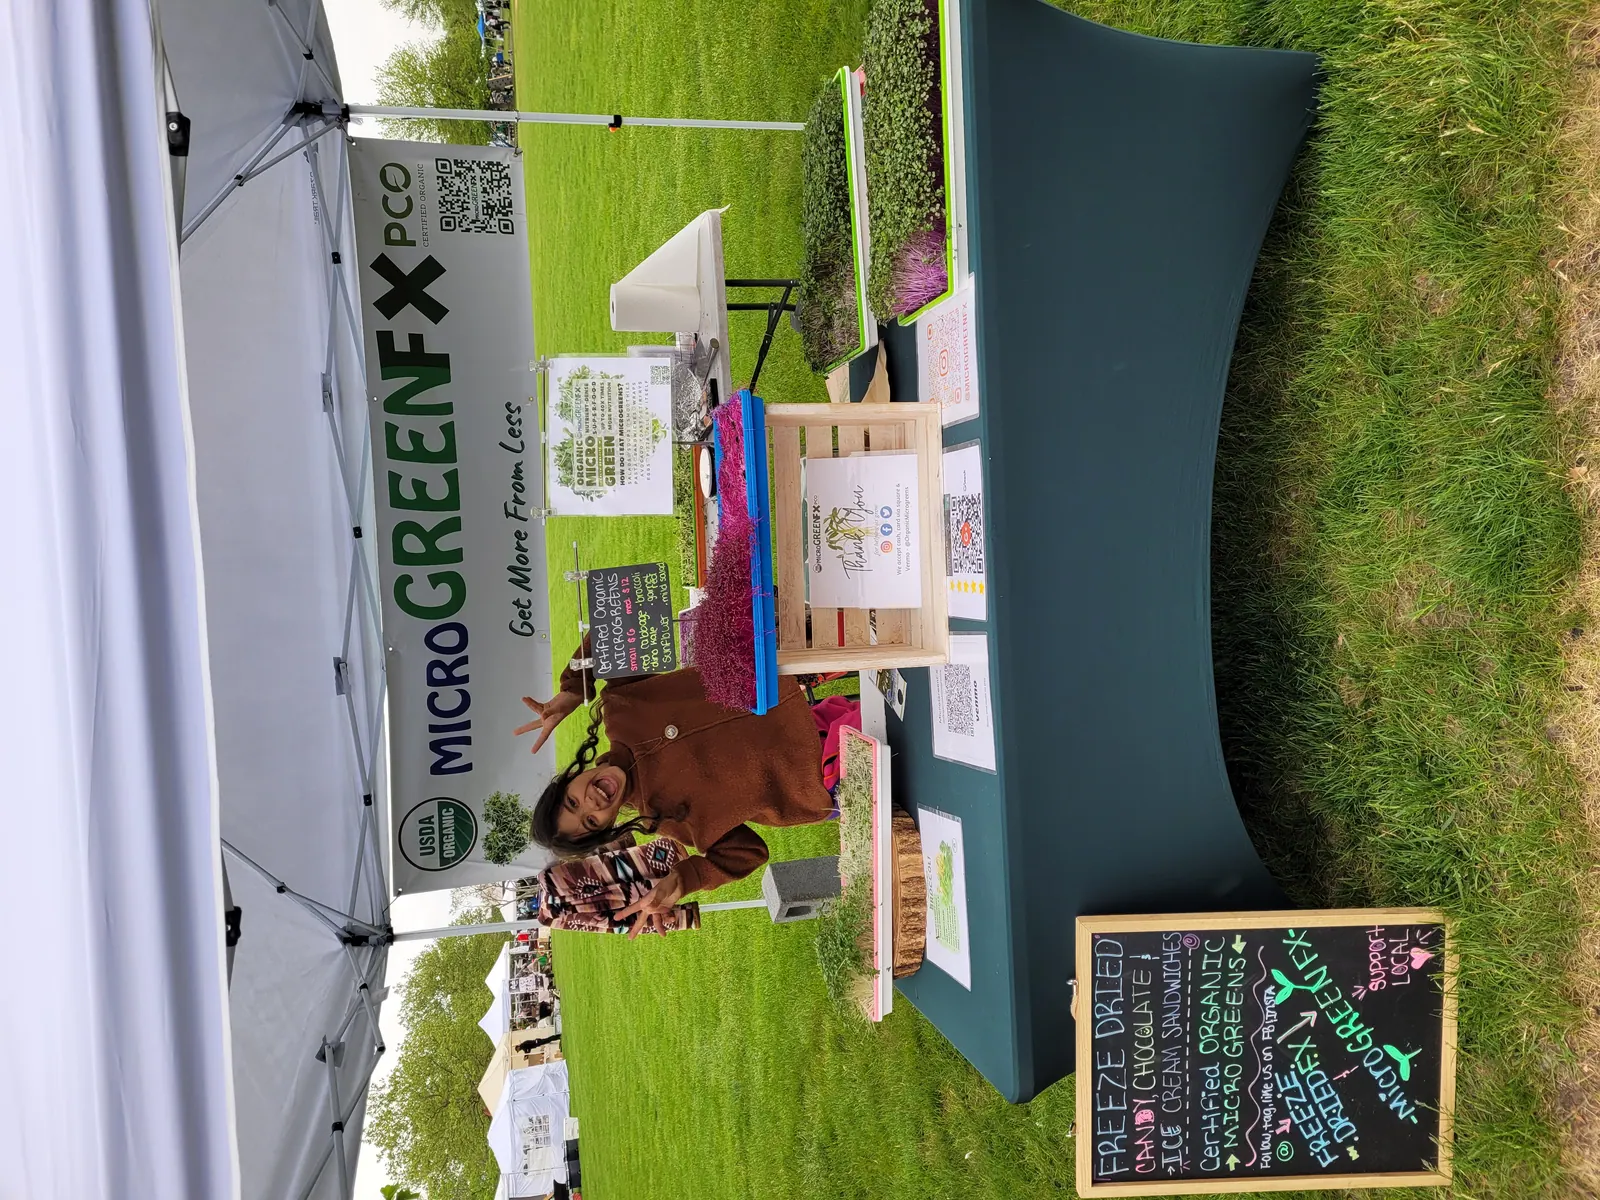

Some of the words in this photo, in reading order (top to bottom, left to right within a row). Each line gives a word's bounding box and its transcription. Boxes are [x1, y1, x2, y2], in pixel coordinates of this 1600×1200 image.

[379, 162, 417, 247] PCO
[416, 163, 426, 202] ORGANIC
[420, 203, 430, 248] CERTIFIED
[498, 401, 526, 454] Less
[601, 422, 606, 430] UP
[576, 440, 584, 486] ORGANIC
[585, 436, 596, 486] MICRO
[604, 436, 616, 486] GREEN
[620, 457, 625, 467] DO
[503, 460, 529, 522] From
[842, 484, 874, 524] You
[506, 529, 533, 592] More
[841, 528, 874, 580] Thank
[896, 566, 902, 576] We
[508, 598, 536, 637] Get
[608, 572, 628, 670] MICROGREENS
[638, 610, 650, 650] cabbage
[628, 648, 638, 671] small
[418, 814, 436, 857] USDA
[440, 807, 456, 858] ORGANIC
[1390, 928, 1410, 986] LOCAL
[1094, 938, 1124, 1038] DRIED
[1161, 932, 1182, 1038] SANDWICHES
[1198, 936, 1226, 1054] ORGANIC
[1132, 968, 1156, 1090] CHOCOLATE
[1262, 1046, 1274, 1062] on
[1161, 1044, 1182, 1113] CREAM
[1264, 1064, 1274, 1080] us
[1096, 1048, 1129, 1176] FREEZE
[1200, 1062, 1220, 1172] Certified
[1160, 1123, 1182, 1168] ICE
